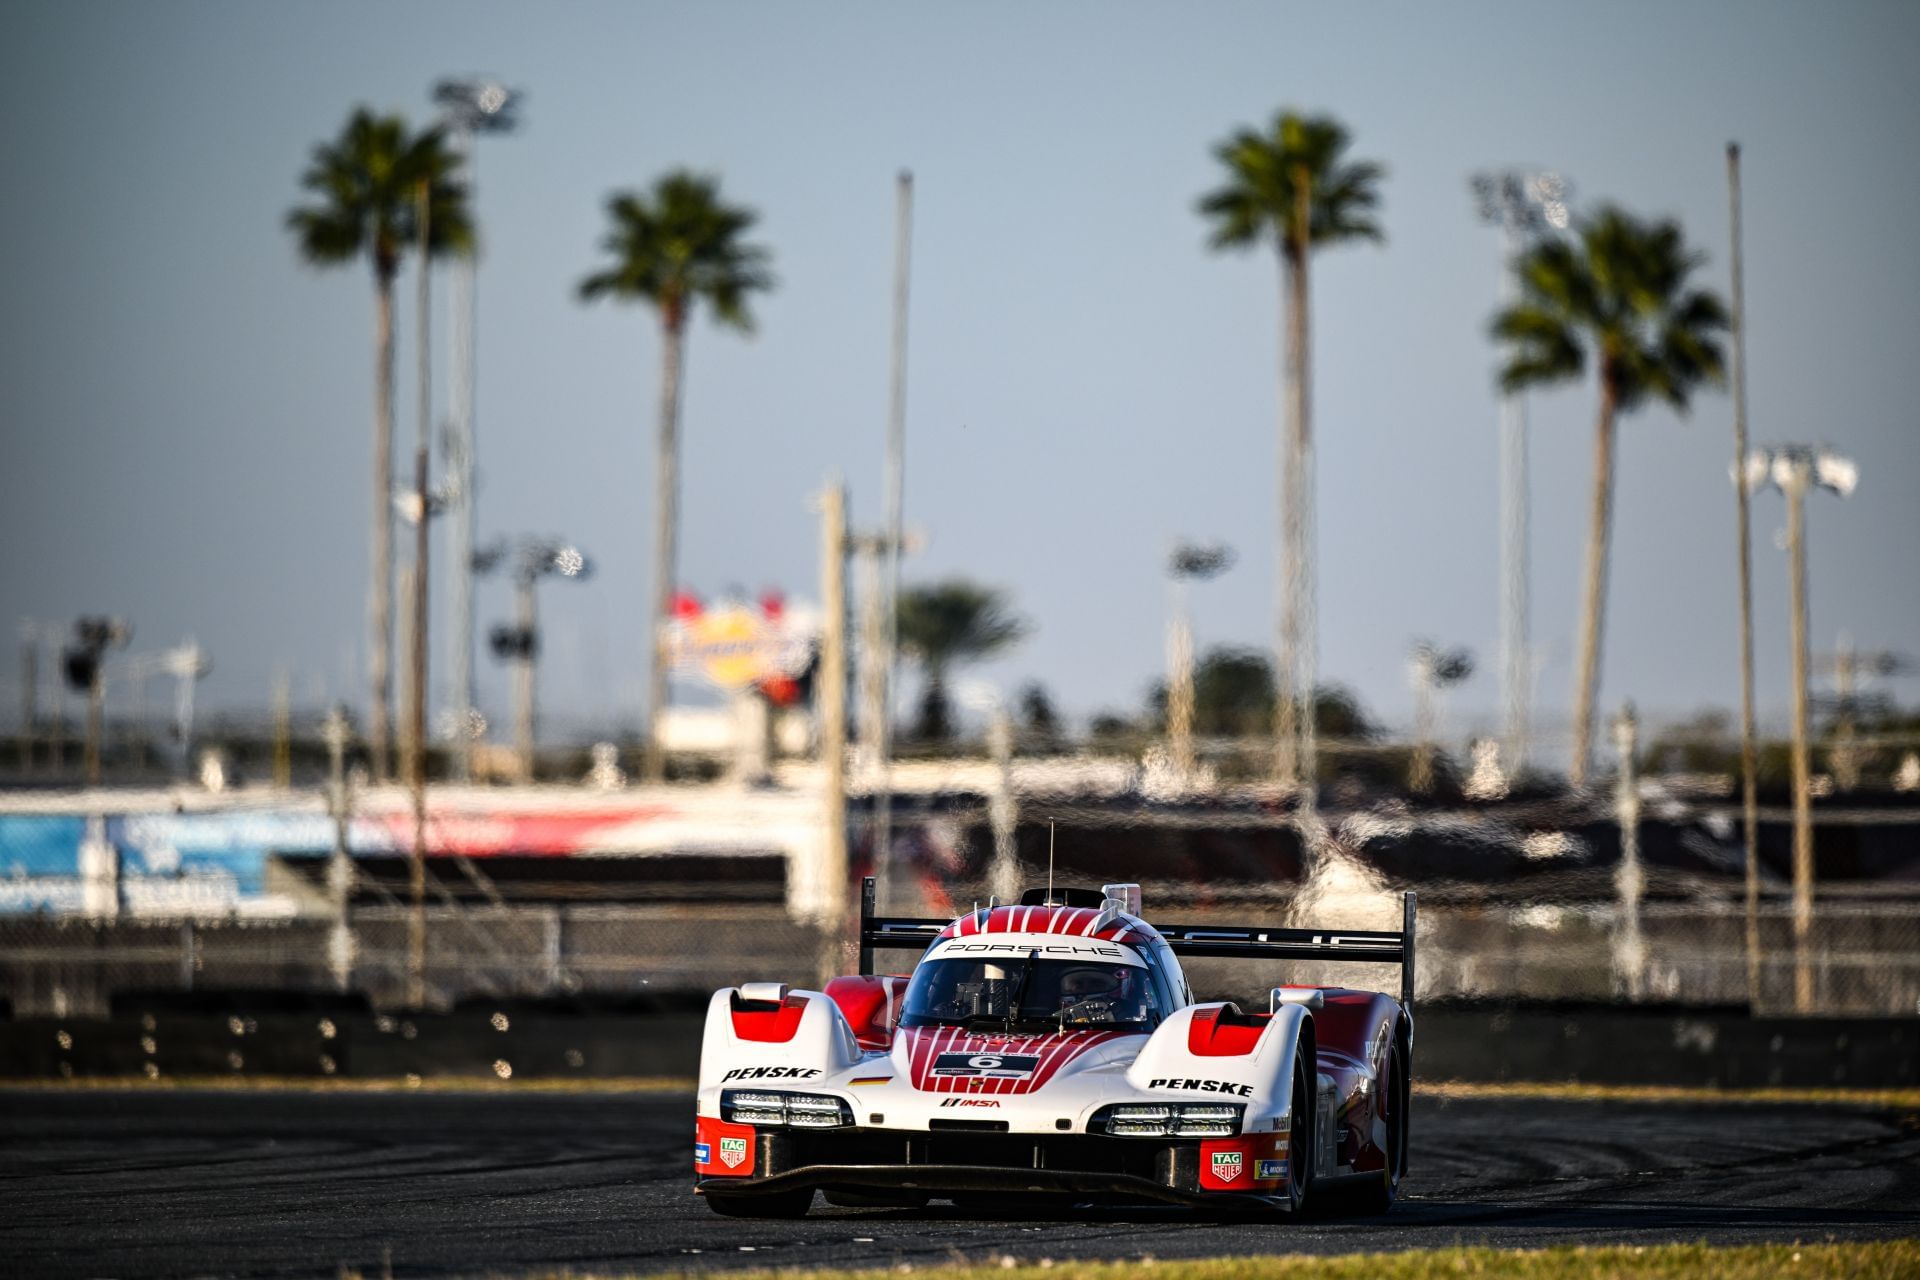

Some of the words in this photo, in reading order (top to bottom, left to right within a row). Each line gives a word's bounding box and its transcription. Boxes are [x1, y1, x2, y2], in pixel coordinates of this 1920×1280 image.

[944, 944, 1123, 957] PORSCHE
[968, 1055, 1004, 1069] 6
[721, 1067, 822, 1083] PENSKE
[1148, 1079, 1254, 1098] PENSKE
[959, 1099, 1001, 1108] IMSA
[722, 1140, 744, 1150] TAG
[721, 1151, 745, 1166] HEUER
[1214, 1154, 1240, 1164] TAG
[1214, 1165, 1240, 1180] HEUER
